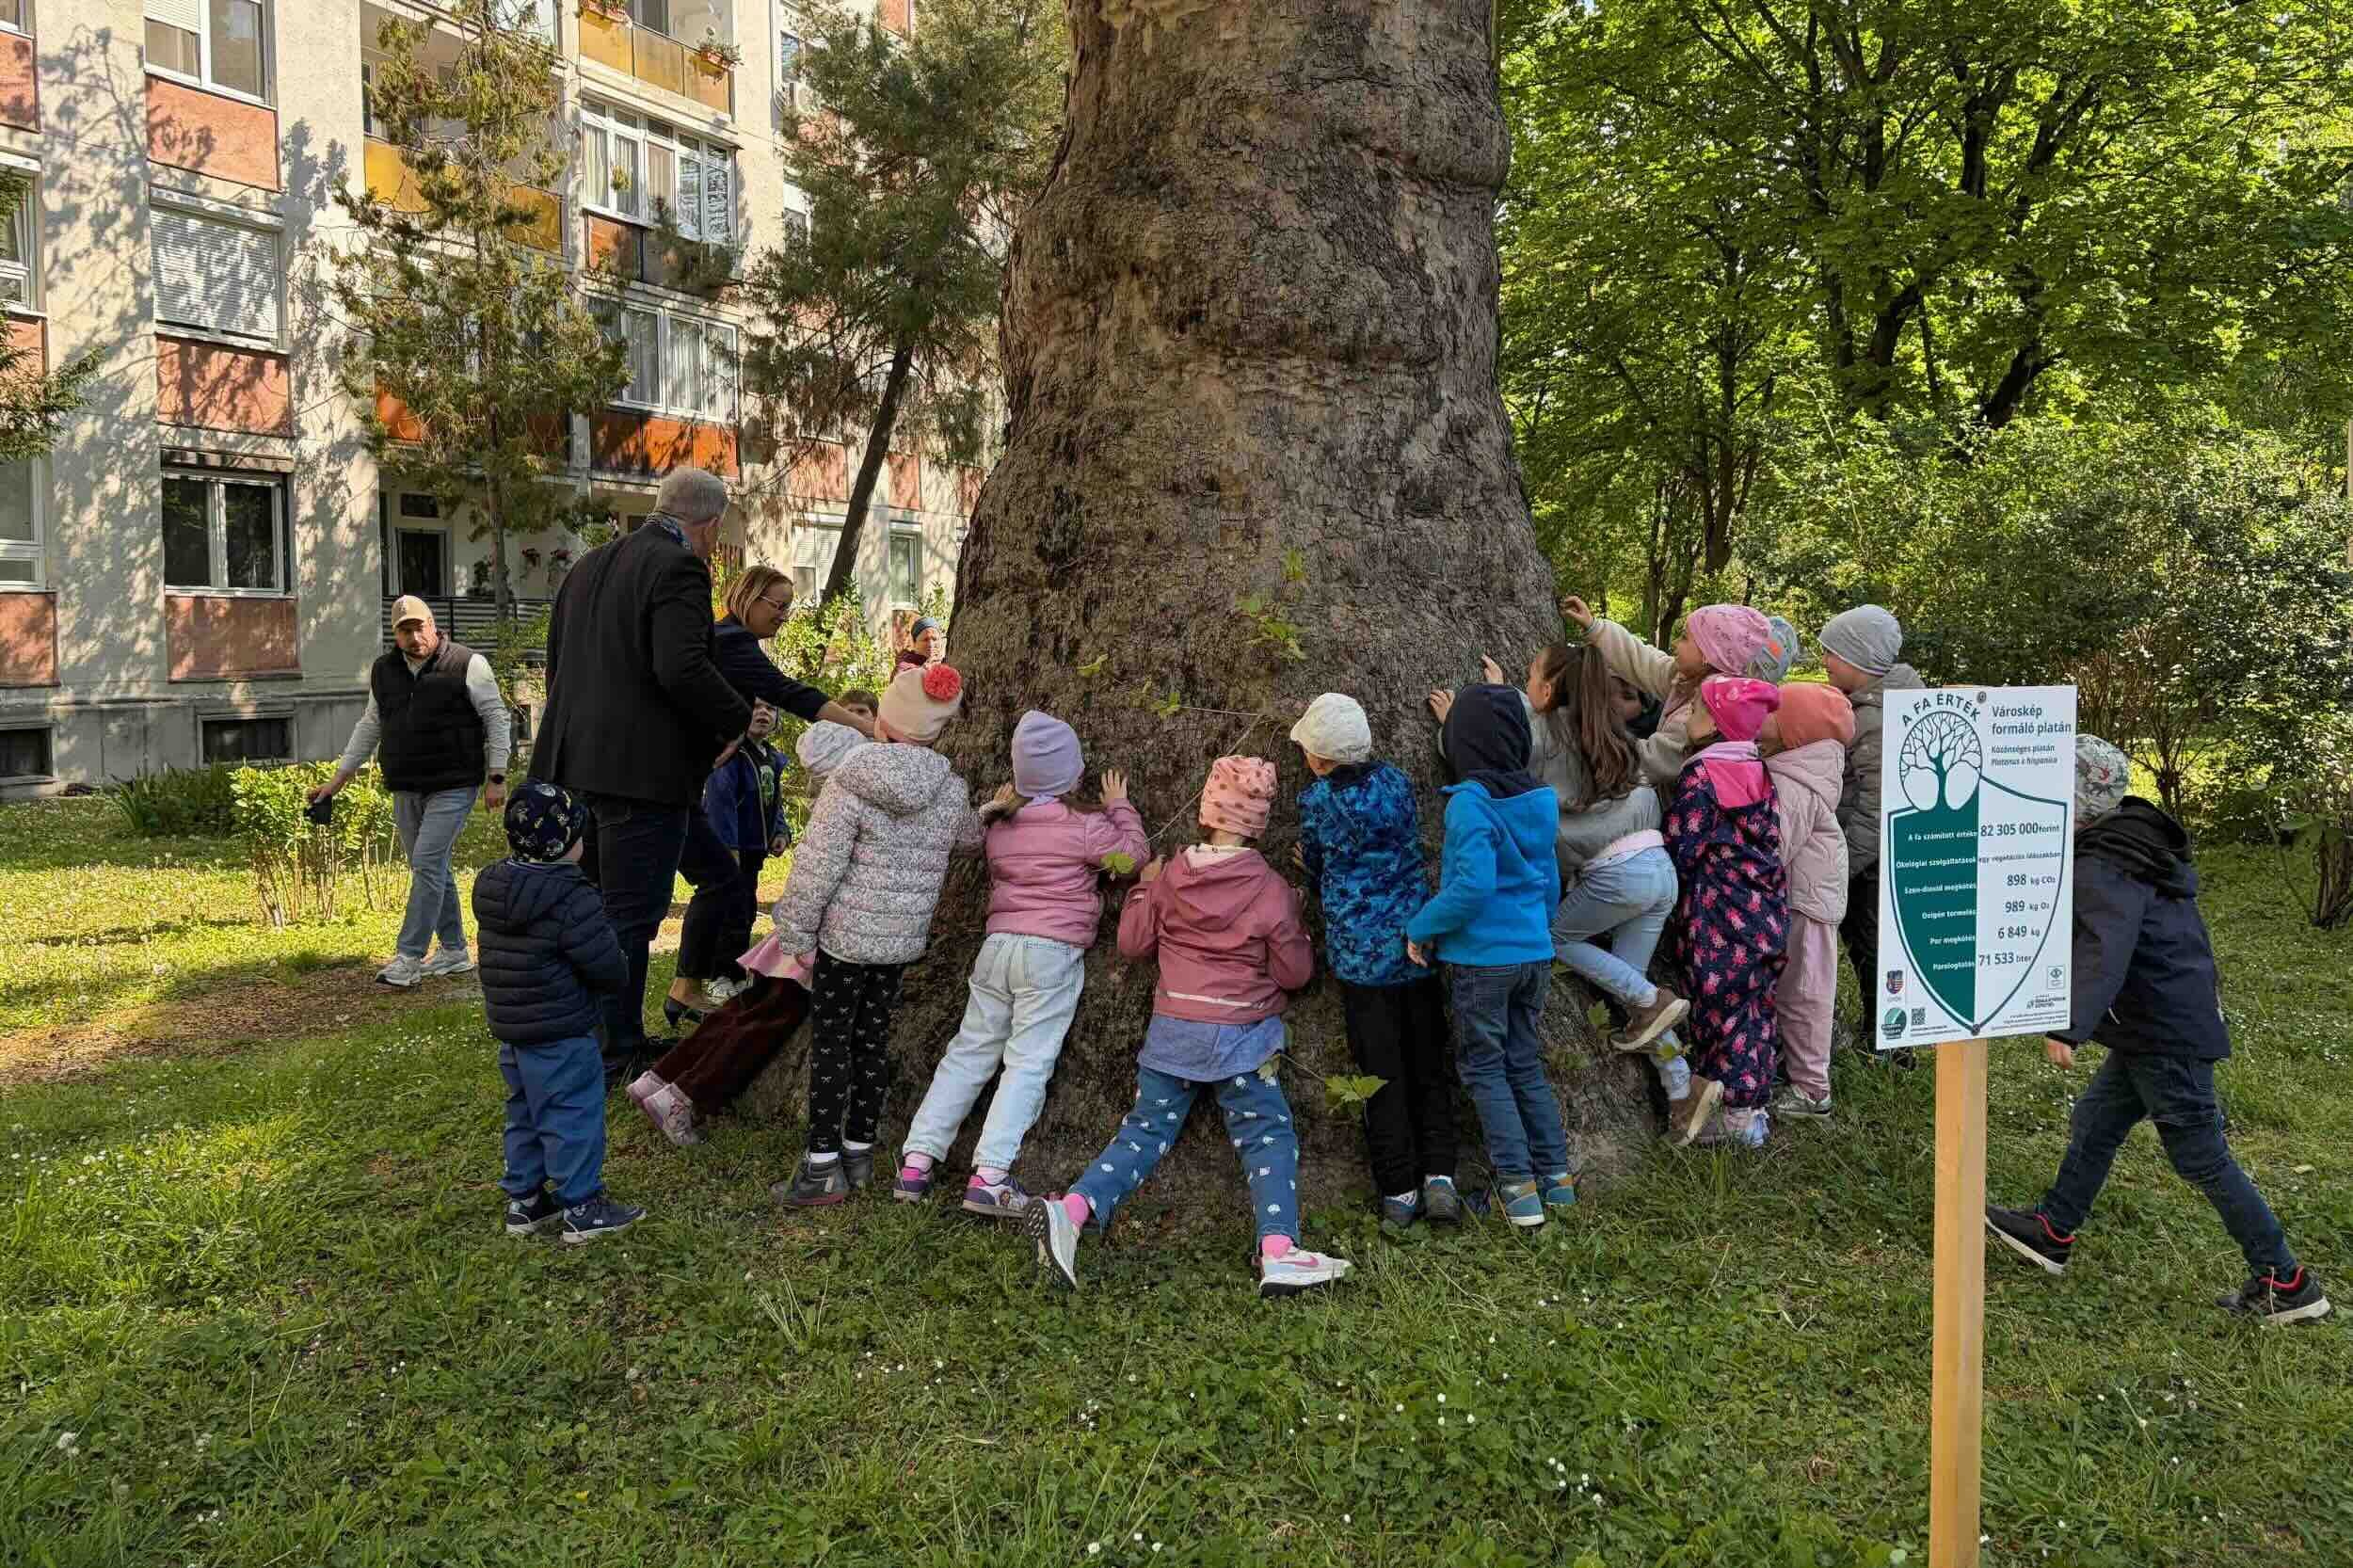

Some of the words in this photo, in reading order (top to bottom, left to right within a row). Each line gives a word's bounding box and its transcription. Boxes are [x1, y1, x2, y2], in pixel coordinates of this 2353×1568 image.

[1902, 715, 1913, 727] A
[1913, 697, 1931, 714] FA
[1936, 691, 1981, 722] ÉRTÉK
[1992, 704, 2042, 719] Városkép
[1992, 722, 2035, 735] formáló
[2037, 721, 2071, 736] platán
[2032, 744, 2056, 755] platán
[1908, 833, 1913, 841] A
[1914, 832, 1922, 840] fa
[1923, 831, 1955, 840] számított
[1980, 824, 1994, 837] 82
[1996, 823, 2016, 836] 305
[2019, 822, 2039, 835] 000
[2007, 873, 2026, 887] 898
[2030, 876, 2040, 886] kg
[2005, 900, 2025, 913] 989
[2029, 903, 2039, 912] kg
[1997, 926, 2005, 939] 6
[2007, 925, 2027, 938] 849
[2030, 928, 2040, 937] kg
[1978, 953, 1991, 967] 71
[1994, 952, 2014, 965] 533
